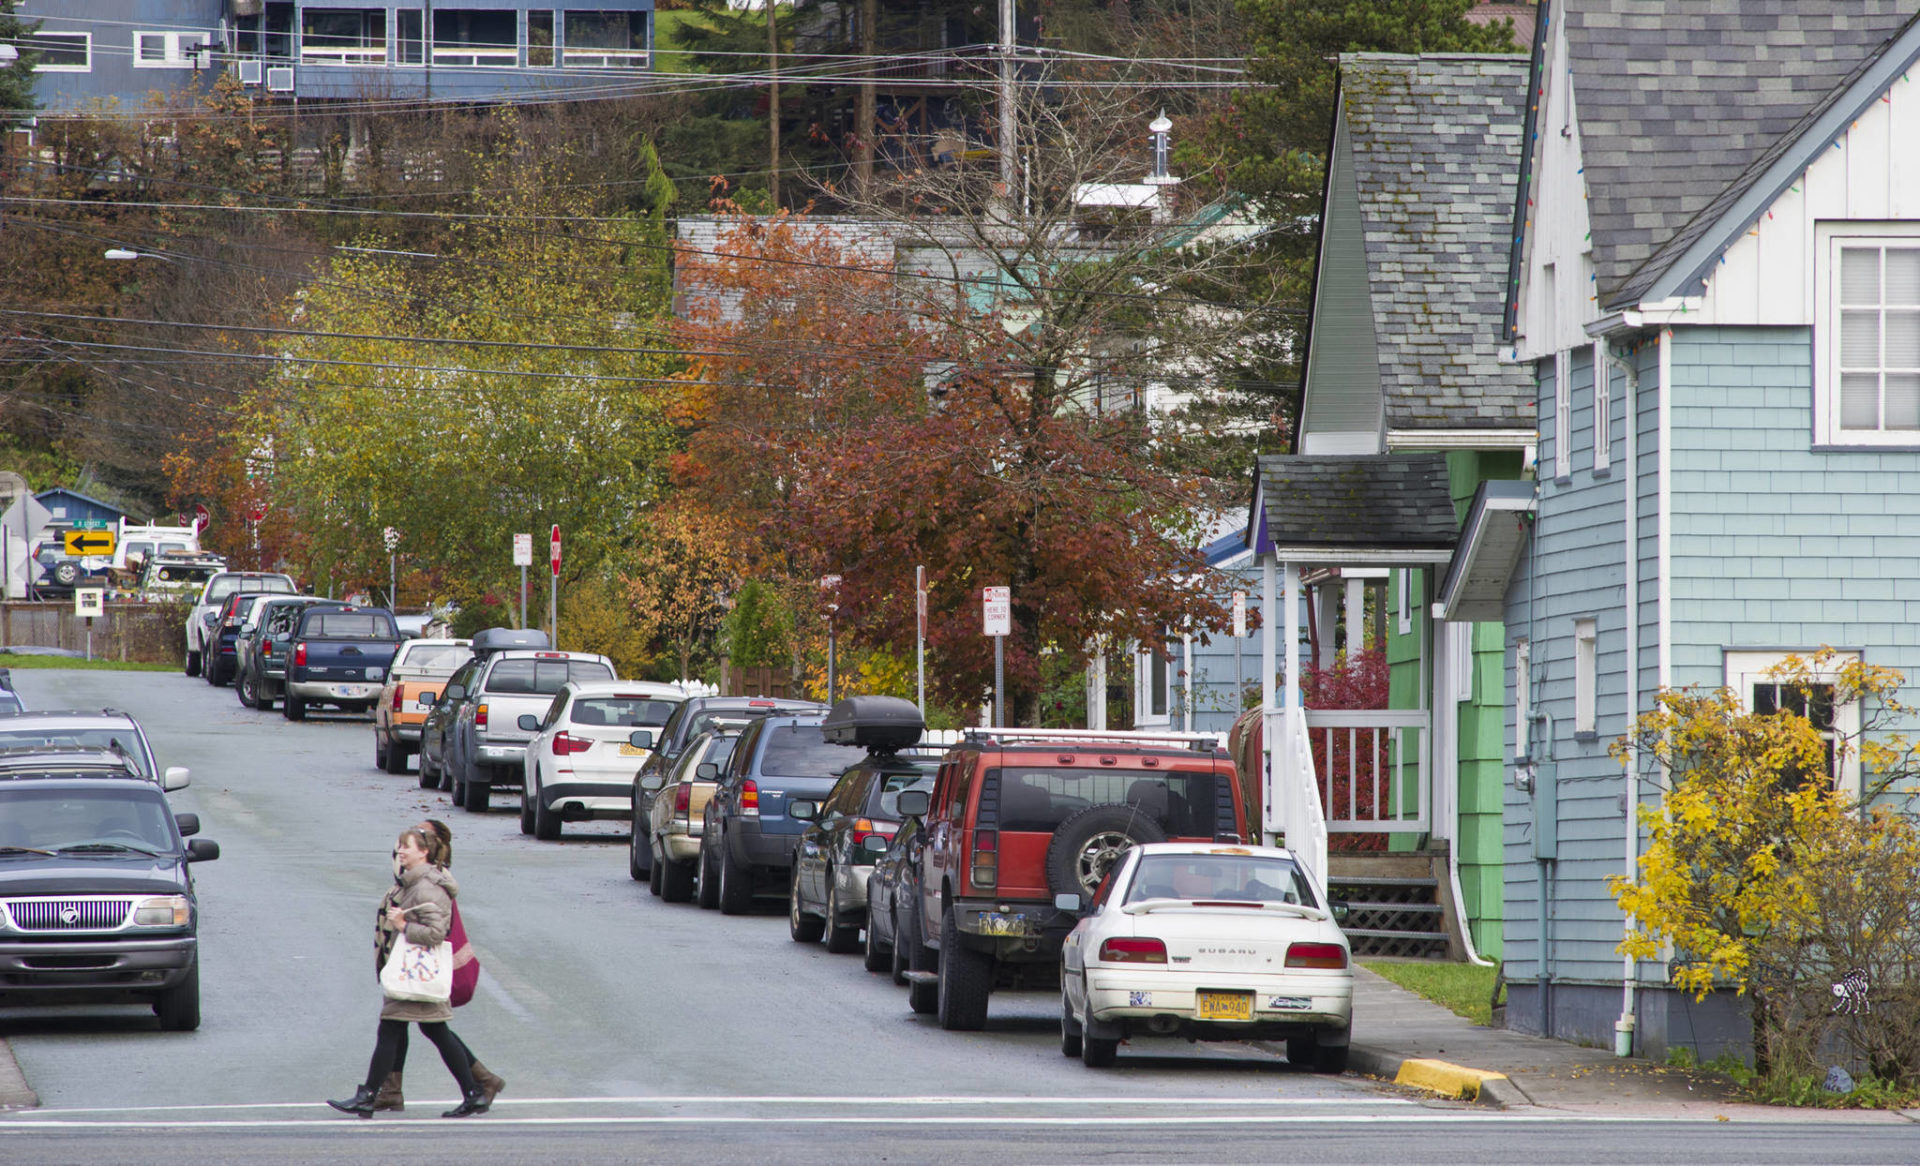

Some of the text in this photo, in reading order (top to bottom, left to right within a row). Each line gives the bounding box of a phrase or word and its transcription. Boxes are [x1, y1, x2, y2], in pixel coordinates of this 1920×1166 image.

[180, 512, 207, 525] SOP
[1203, 999, 1248, 1014] EWA 940
